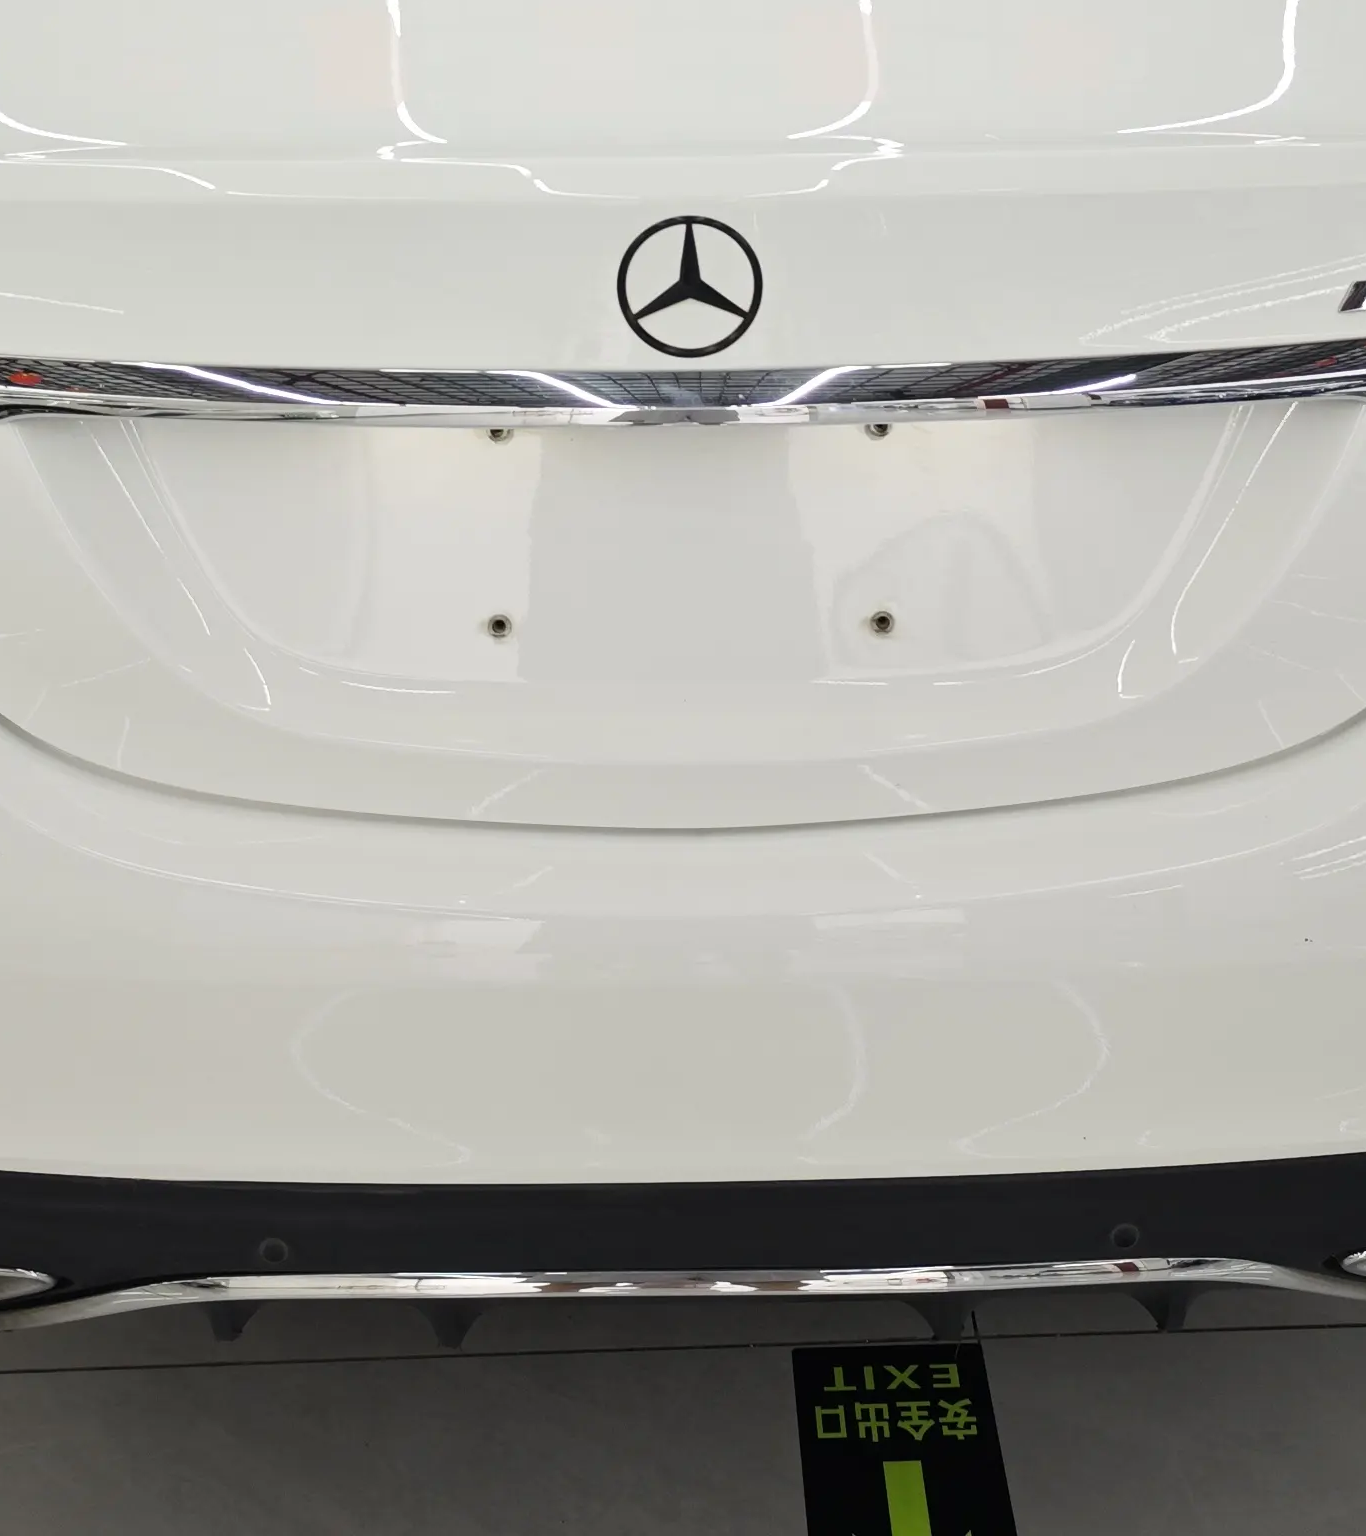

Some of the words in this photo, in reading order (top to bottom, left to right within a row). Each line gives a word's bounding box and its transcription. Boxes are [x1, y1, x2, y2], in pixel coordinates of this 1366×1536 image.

[823, 1363, 962, 1392] EXIT
[814, 1397, 978, 1443] 安全出口
